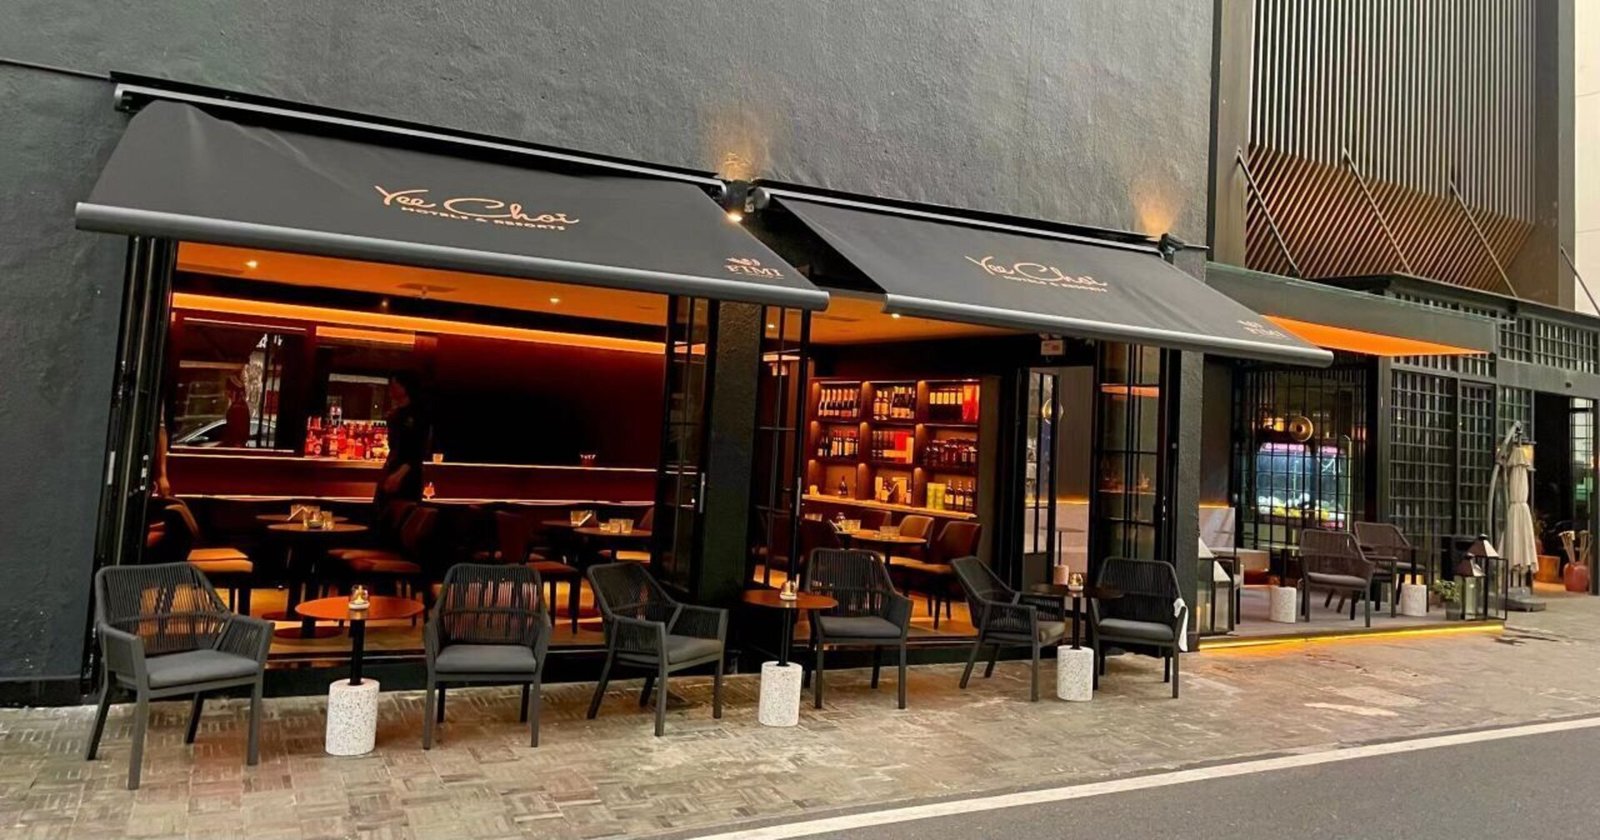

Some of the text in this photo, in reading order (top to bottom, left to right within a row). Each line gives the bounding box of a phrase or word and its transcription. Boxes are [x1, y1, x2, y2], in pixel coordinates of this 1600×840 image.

[374, 185, 580, 224] Yee Choi
[964, 255, 1015, 275] Yee
